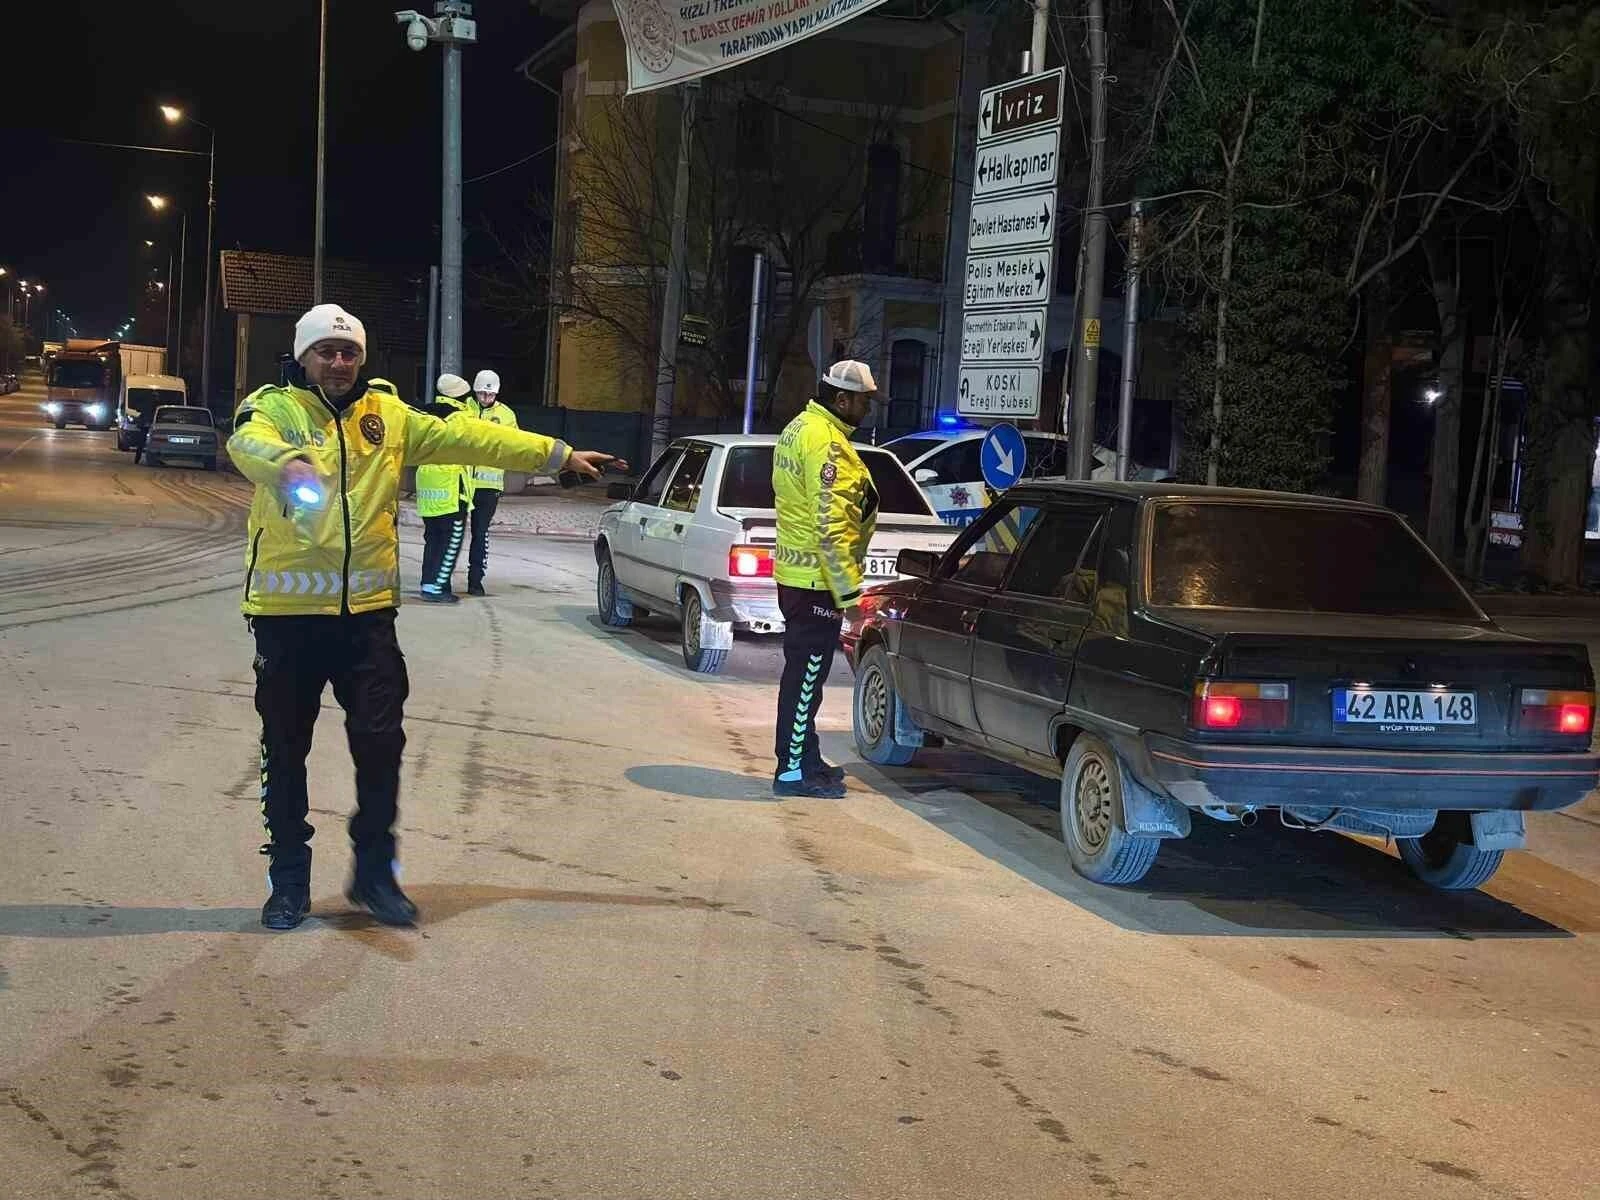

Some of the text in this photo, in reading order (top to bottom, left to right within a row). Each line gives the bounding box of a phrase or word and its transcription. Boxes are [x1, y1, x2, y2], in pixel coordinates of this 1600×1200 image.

[700, 18, 731, 40] DEVLET
[720, 24, 784, 57] TARAFINDAN
[997, 92, 1044, 124] İvriz
[987, 152, 1054, 184] Halkapınar
[972, 211, 1039, 237] Devlet Hastanesi
[968, 259, 1035, 279] Polis Meslek
[966, 281, 1033, 302] Eğitim Merkezi
[964, 337, 1028, 357] Ereğli Yerleşkesi
[986, 371, 1021, 391] KOSKİ
[970, 394, 1033, 410] Ereğli Şubesi
[870, 559, 896, 574] 817
[1348, 694, 1376, 719] 42
[1384, 694, 1424, 720] ARA
[1434, 695, 1473, 721] 148
